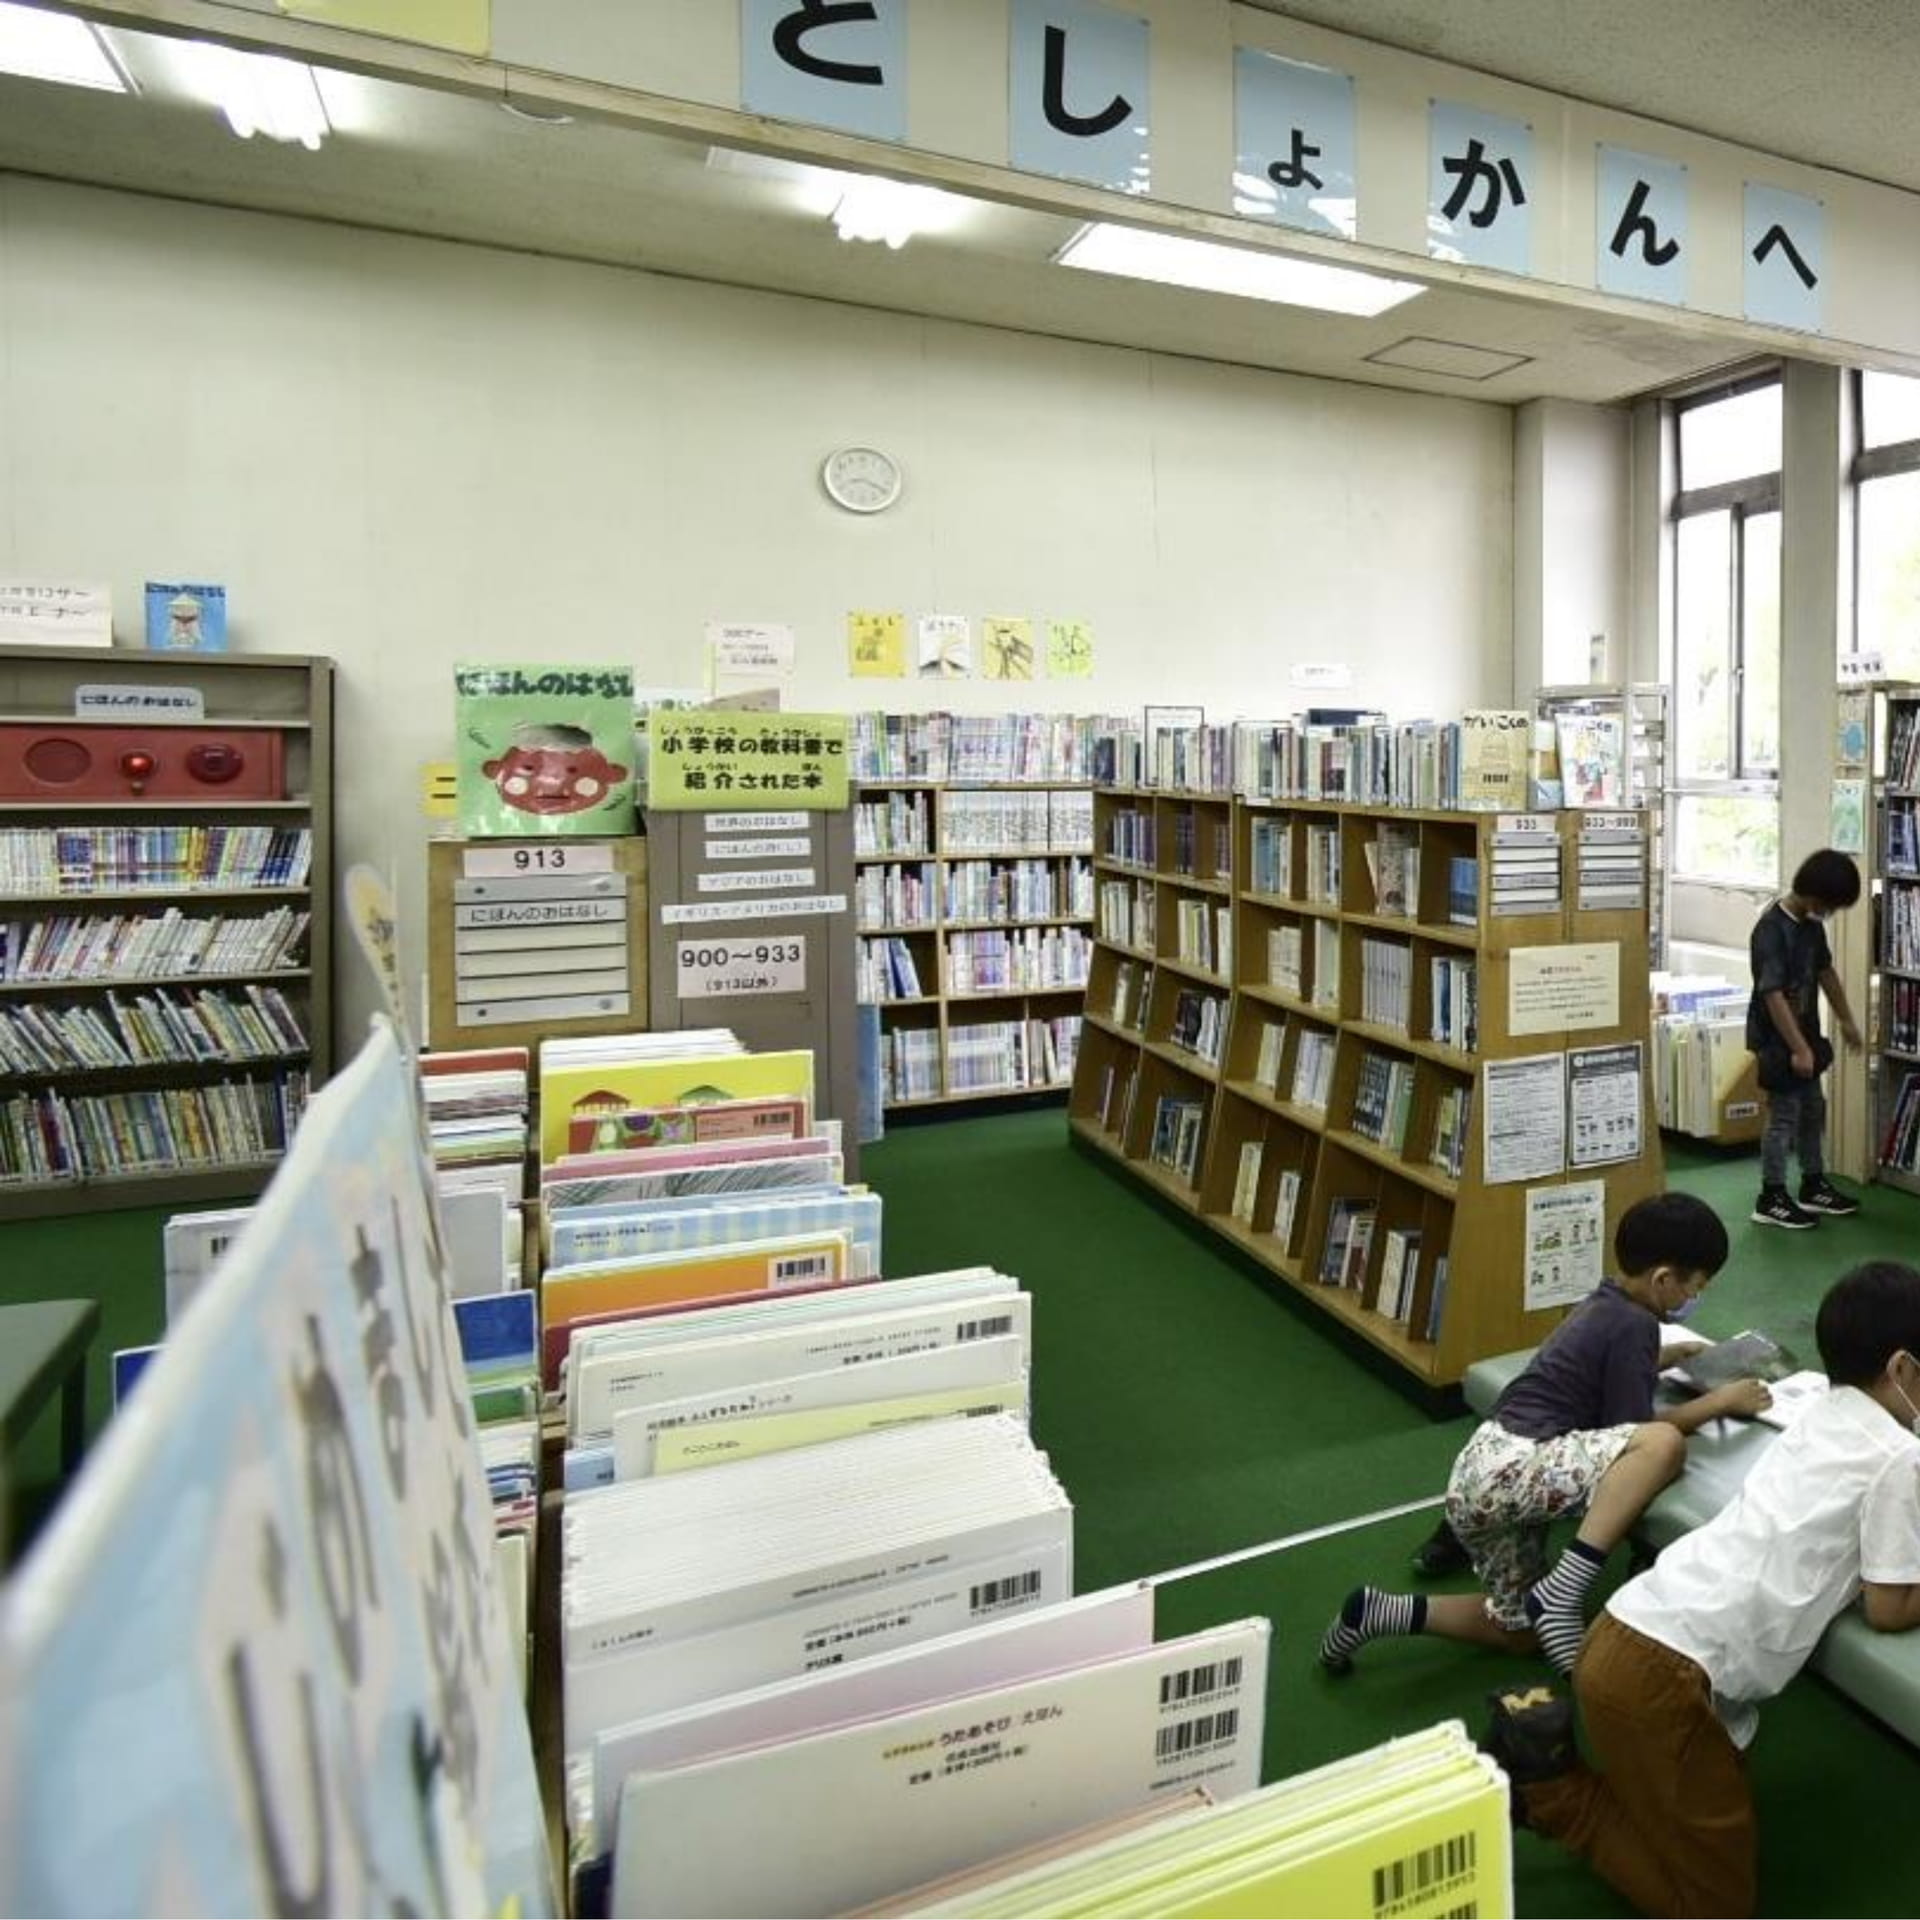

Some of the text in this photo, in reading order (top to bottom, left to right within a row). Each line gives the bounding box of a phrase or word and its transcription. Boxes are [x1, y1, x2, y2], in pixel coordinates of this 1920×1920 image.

[661, 736, 843, 757] 小学校の教科書で
[685, 772, 823, 791] 紹介された本
[513, 848, 566, 870] 913
[471, 904, 608, 923] にほんのおはなし
